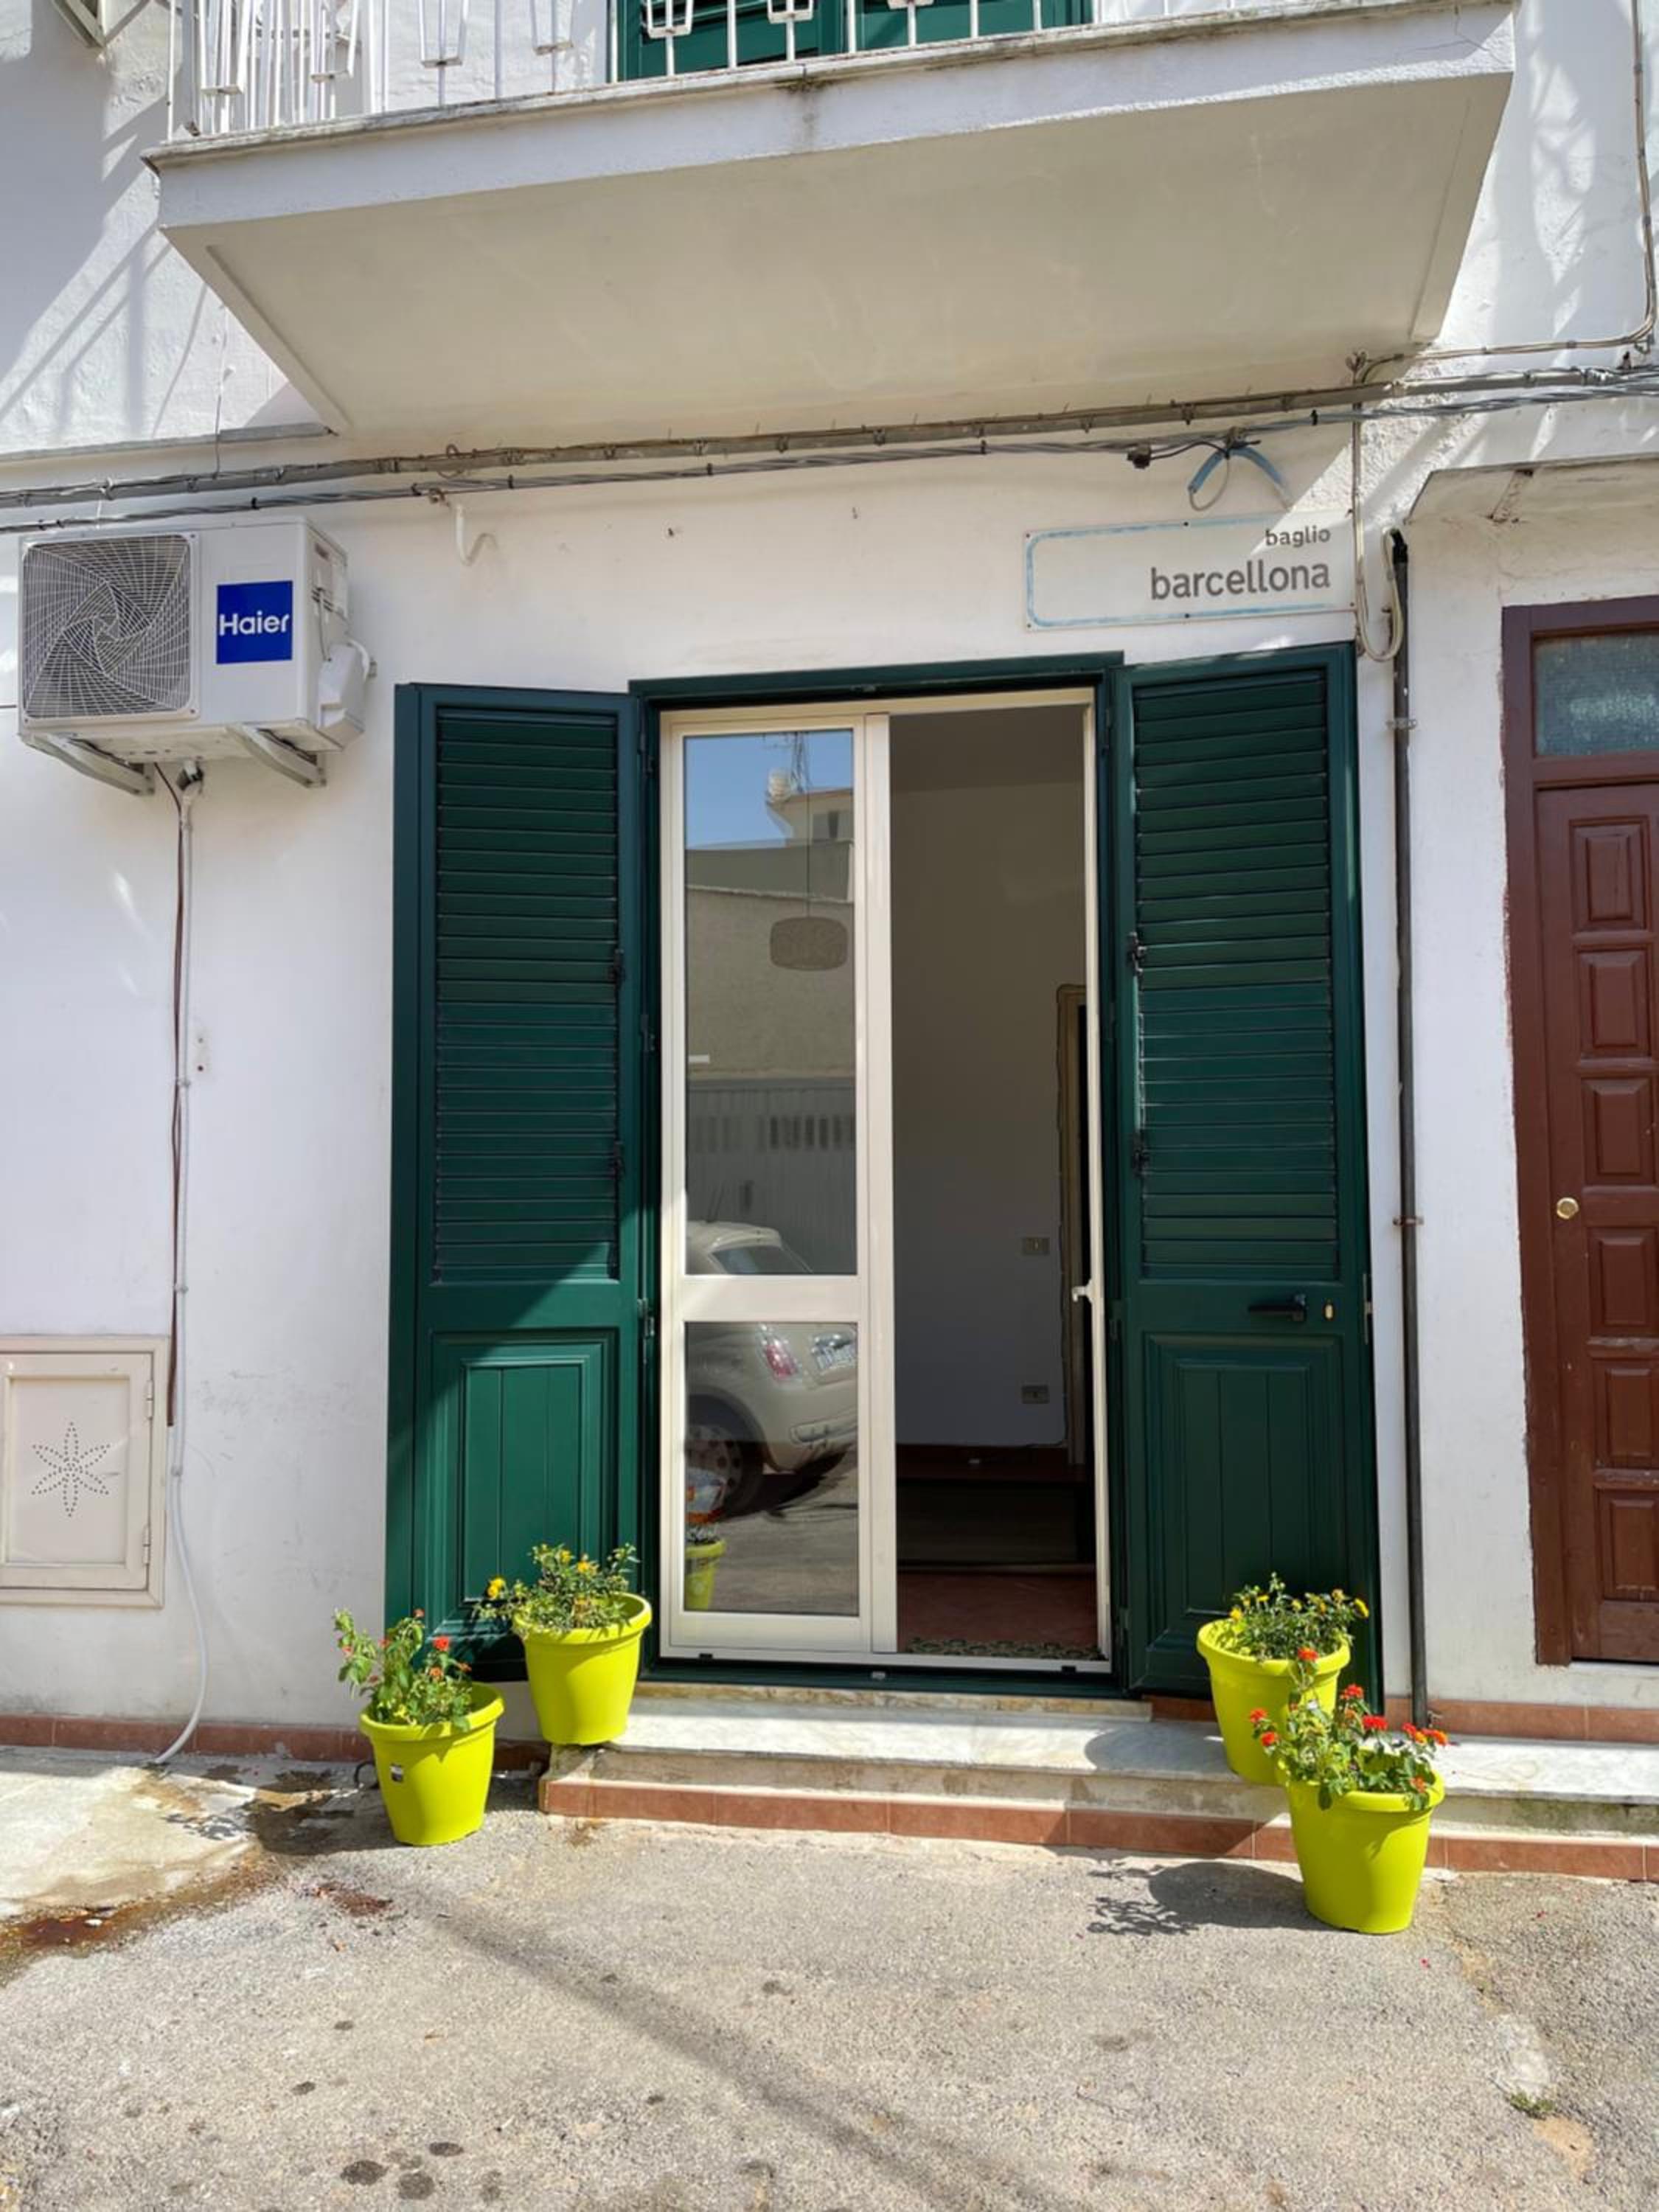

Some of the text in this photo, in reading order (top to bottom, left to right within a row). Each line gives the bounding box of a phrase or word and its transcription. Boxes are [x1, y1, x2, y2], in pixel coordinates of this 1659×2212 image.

[1265, 526, 1331, 548] baglio
[1150, 560, 1330, 600] barcellona
[219, 610, 290, 636] Haier
